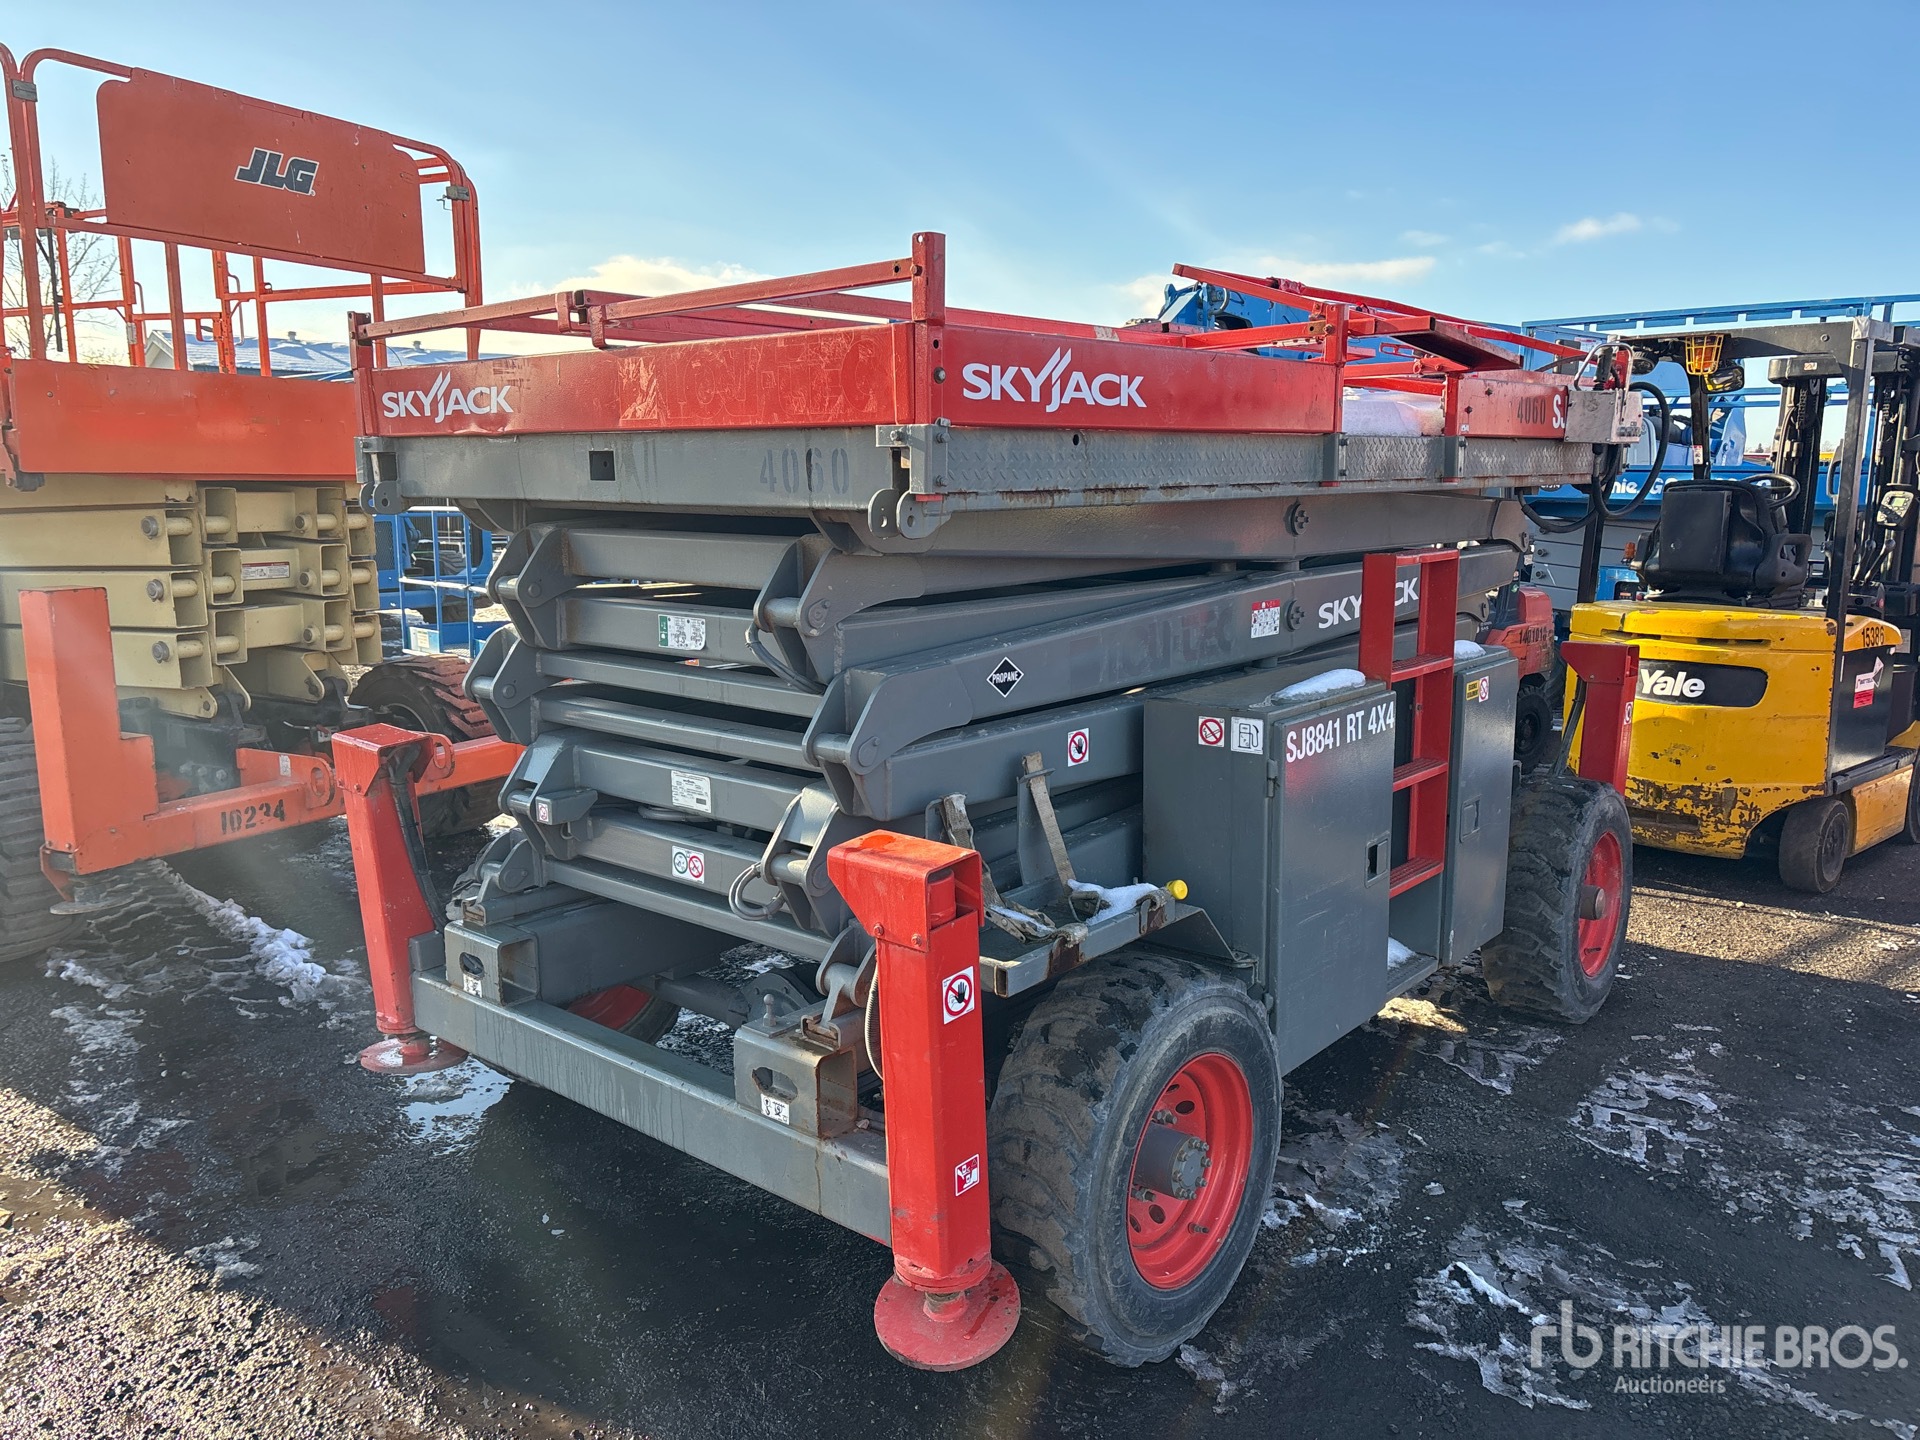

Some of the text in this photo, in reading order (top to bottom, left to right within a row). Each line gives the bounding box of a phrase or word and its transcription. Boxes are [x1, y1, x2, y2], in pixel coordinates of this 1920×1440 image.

[234, 147, 319, 195] JLG
[382, 371, 514, 423] SKYJACK
[962, 347, 1147, 413] SKYJACK
[1517, 397, 1546, 425] 4060
[760, 448, 850, 494] 4060
[1319, 577, 1419, 629] SKYCK
[1861, 626, 1885, 647] 15386
[992, 671, 1018, 684] PROPANE
[1640, 669, 1705, 698] Yale
[1286, 701, 1395, 763] SJ8841 RT 4X4
